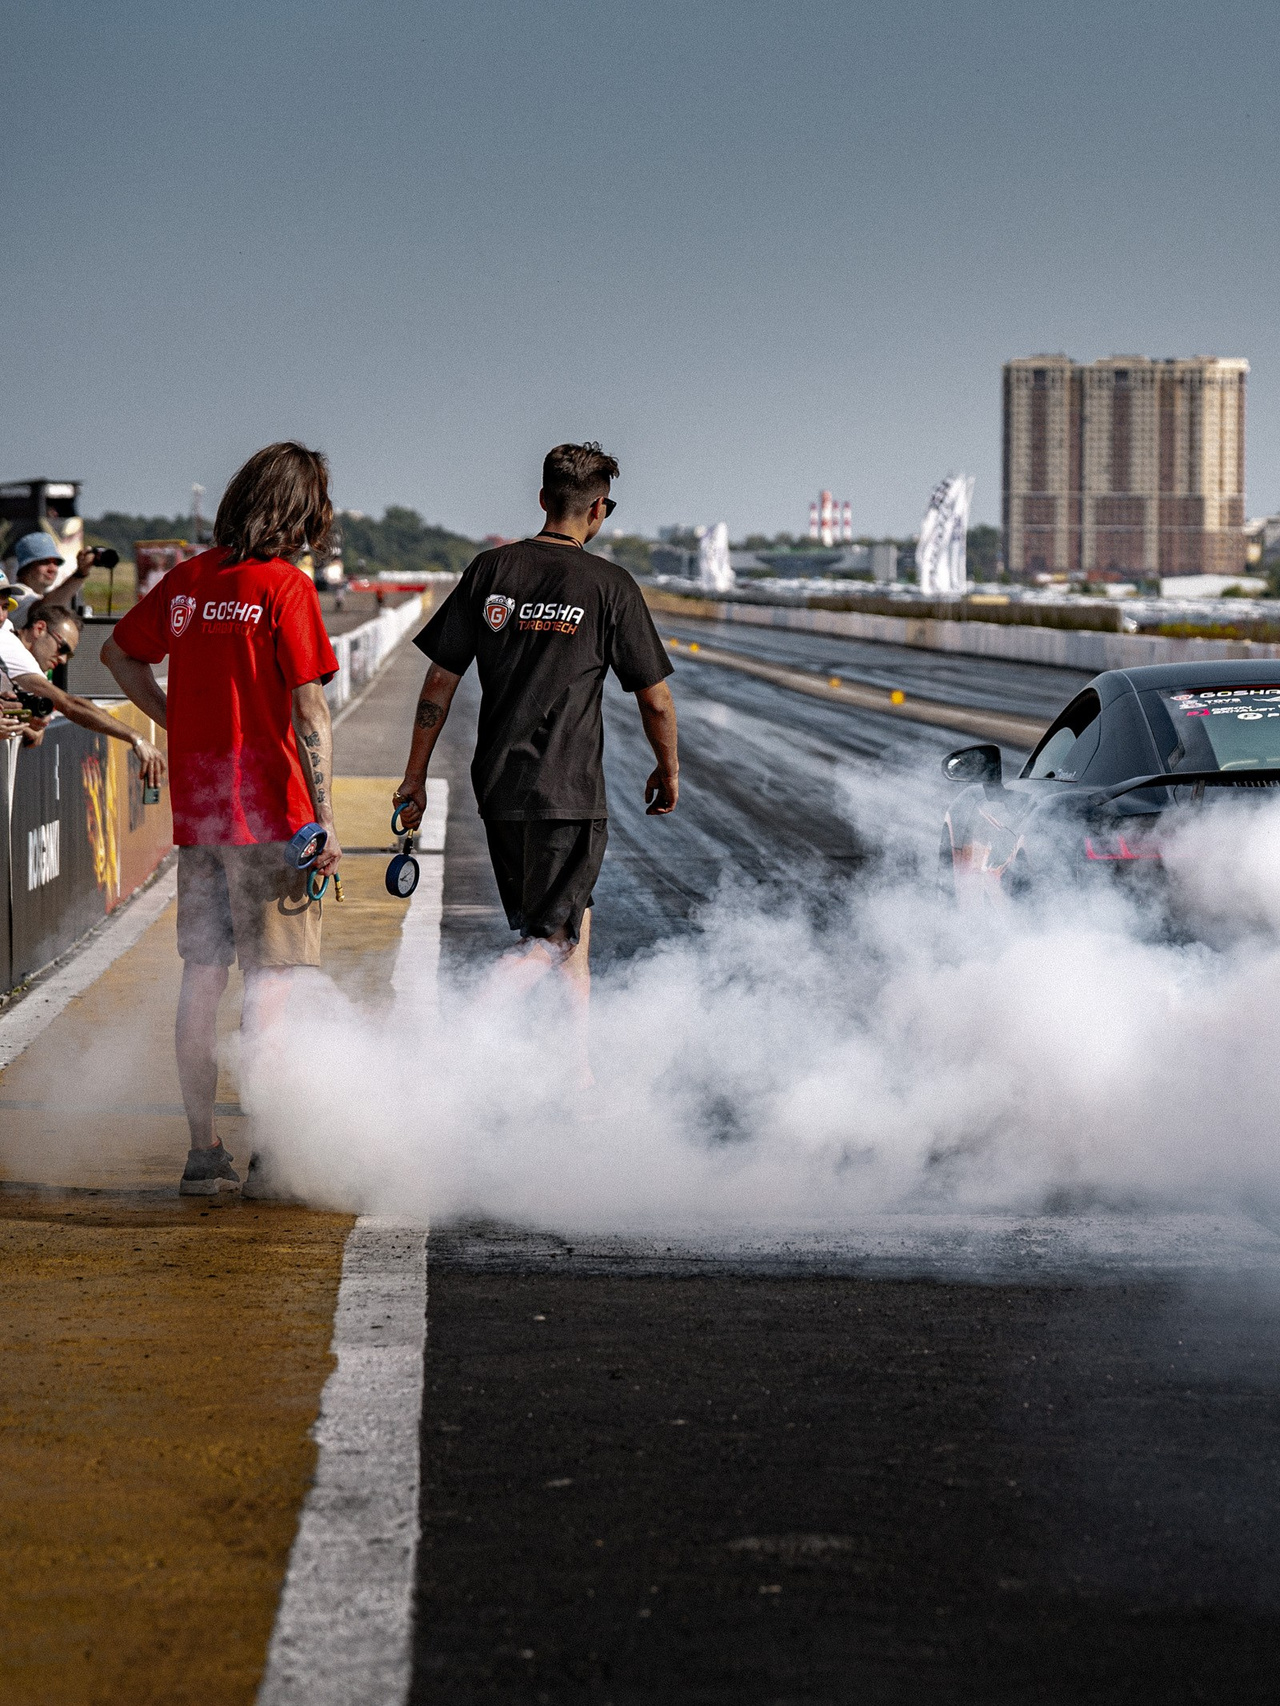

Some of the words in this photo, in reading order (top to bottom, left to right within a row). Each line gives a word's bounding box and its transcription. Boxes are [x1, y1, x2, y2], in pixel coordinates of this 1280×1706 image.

[202, 601, 263, 624] GOSHA
[490, 607, 503, 623] G
[519, 603, 585, 625] GOSHA
